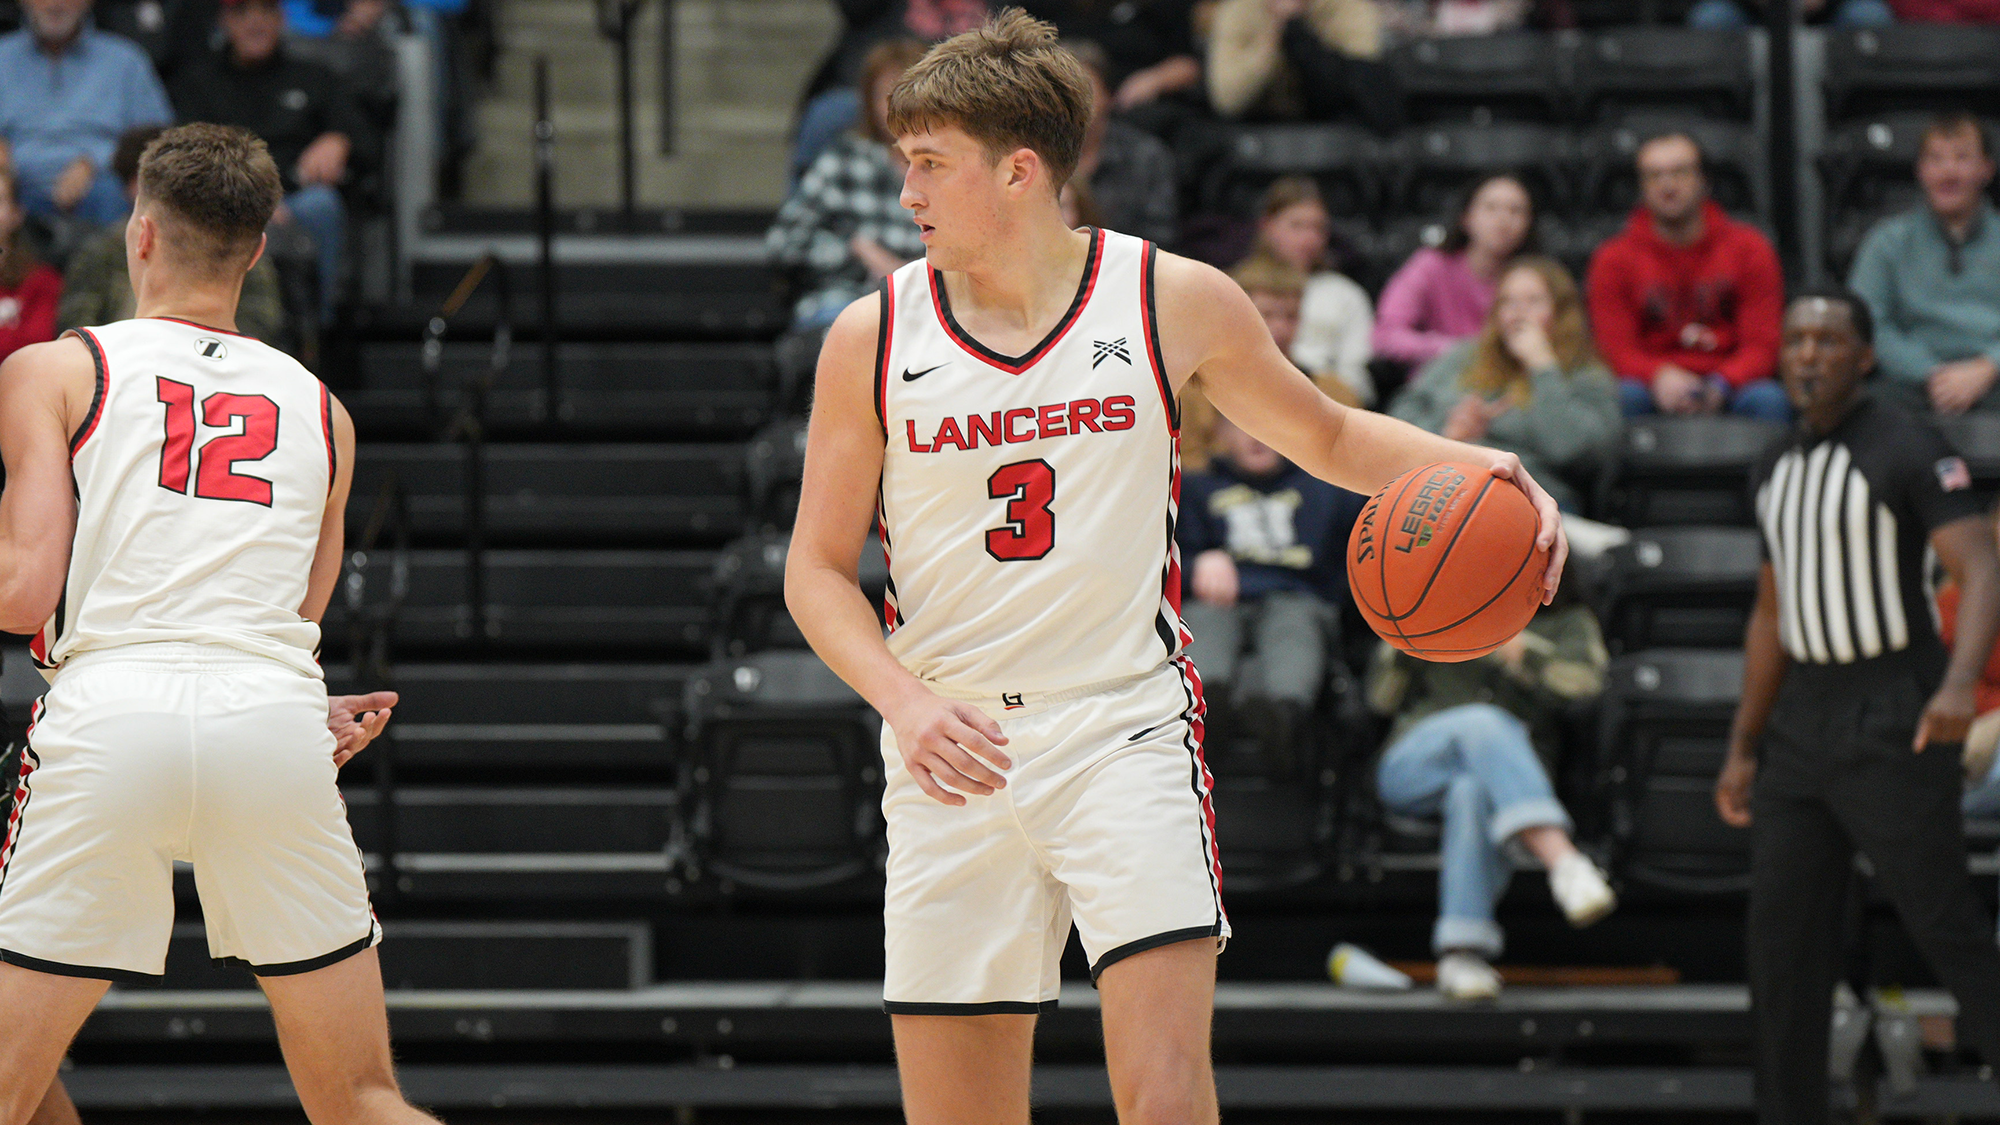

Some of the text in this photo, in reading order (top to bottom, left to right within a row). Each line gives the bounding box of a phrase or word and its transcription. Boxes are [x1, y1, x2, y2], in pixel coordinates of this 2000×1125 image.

[156, 375, 280, 508] 12
[906, 395, 1136, 453] LANCERS
[985, 458, 1056, 562] 3
[1395, 465, 1458, 554] LEGACY
[1427, 474, 1466, 523] 1000
